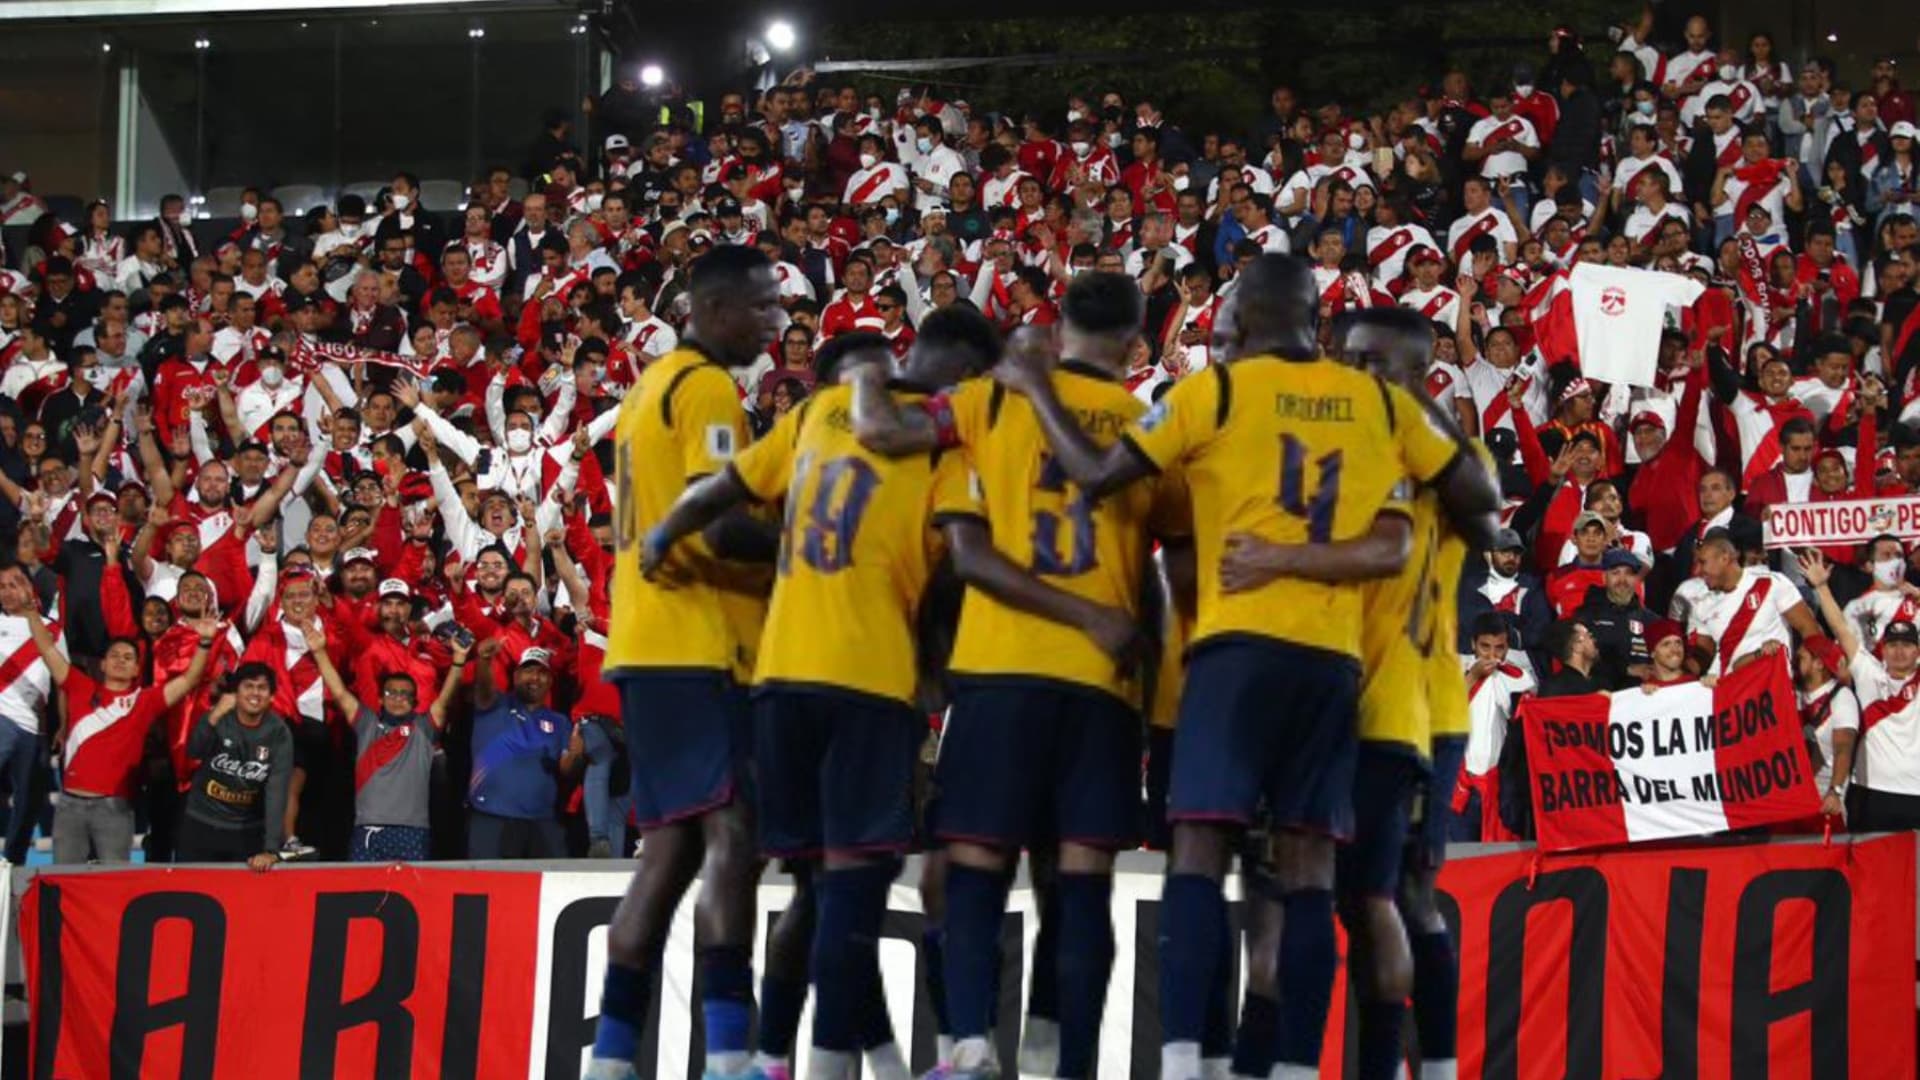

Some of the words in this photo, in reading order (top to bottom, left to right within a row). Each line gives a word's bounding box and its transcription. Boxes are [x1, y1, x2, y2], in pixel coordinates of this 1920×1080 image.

[782, 450, 876, 577] 19
[1276, 432, 1344, 543] 4
[1770, 506, 1867, 537] CONTIGO
[1652, 717, 1687, 757] LA
[1694, 689, 1778, 753] MEJOR
[1539, 769, 1631, 812] BARRA
[1633, 774, 1686, 805] DEL
[1692, 747, 1801, 804] MUNDO!
